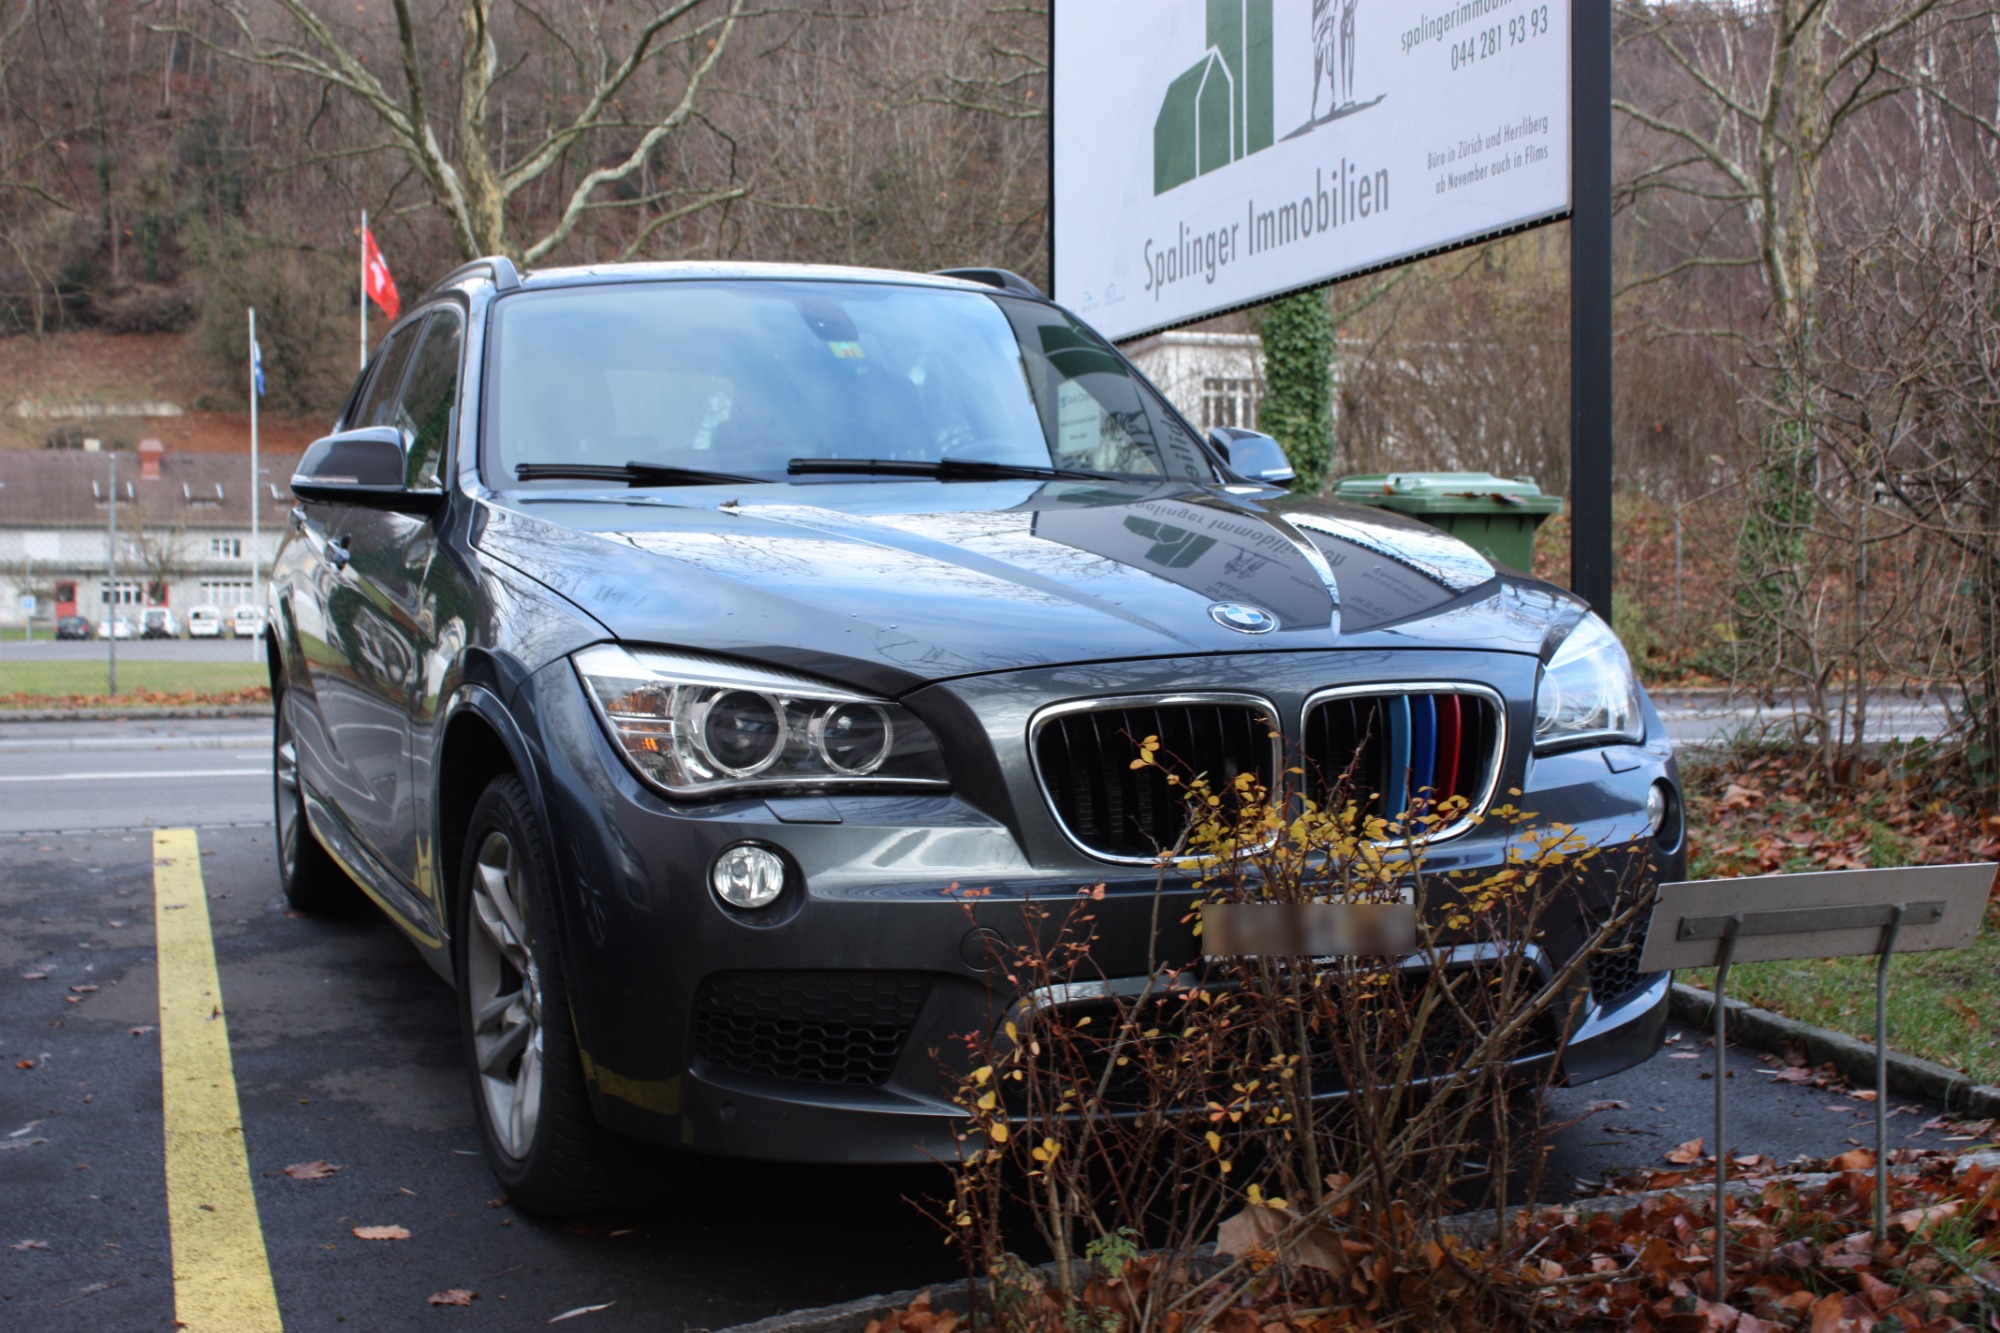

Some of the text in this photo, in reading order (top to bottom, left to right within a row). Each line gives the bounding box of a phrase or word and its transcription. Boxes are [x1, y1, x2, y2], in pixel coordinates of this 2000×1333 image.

[1401, 0, 1517, 55] spalingerimmo
[1451, 5, 1548, 71] 044 281 93 93
[1427, 115, 1548, 170] Büro in Zürich und Herrliberg
[1436, 144, 1548, 194] ab November auch in Flims
[1145, 157, 1389, 301] Spalinger Immobilien
